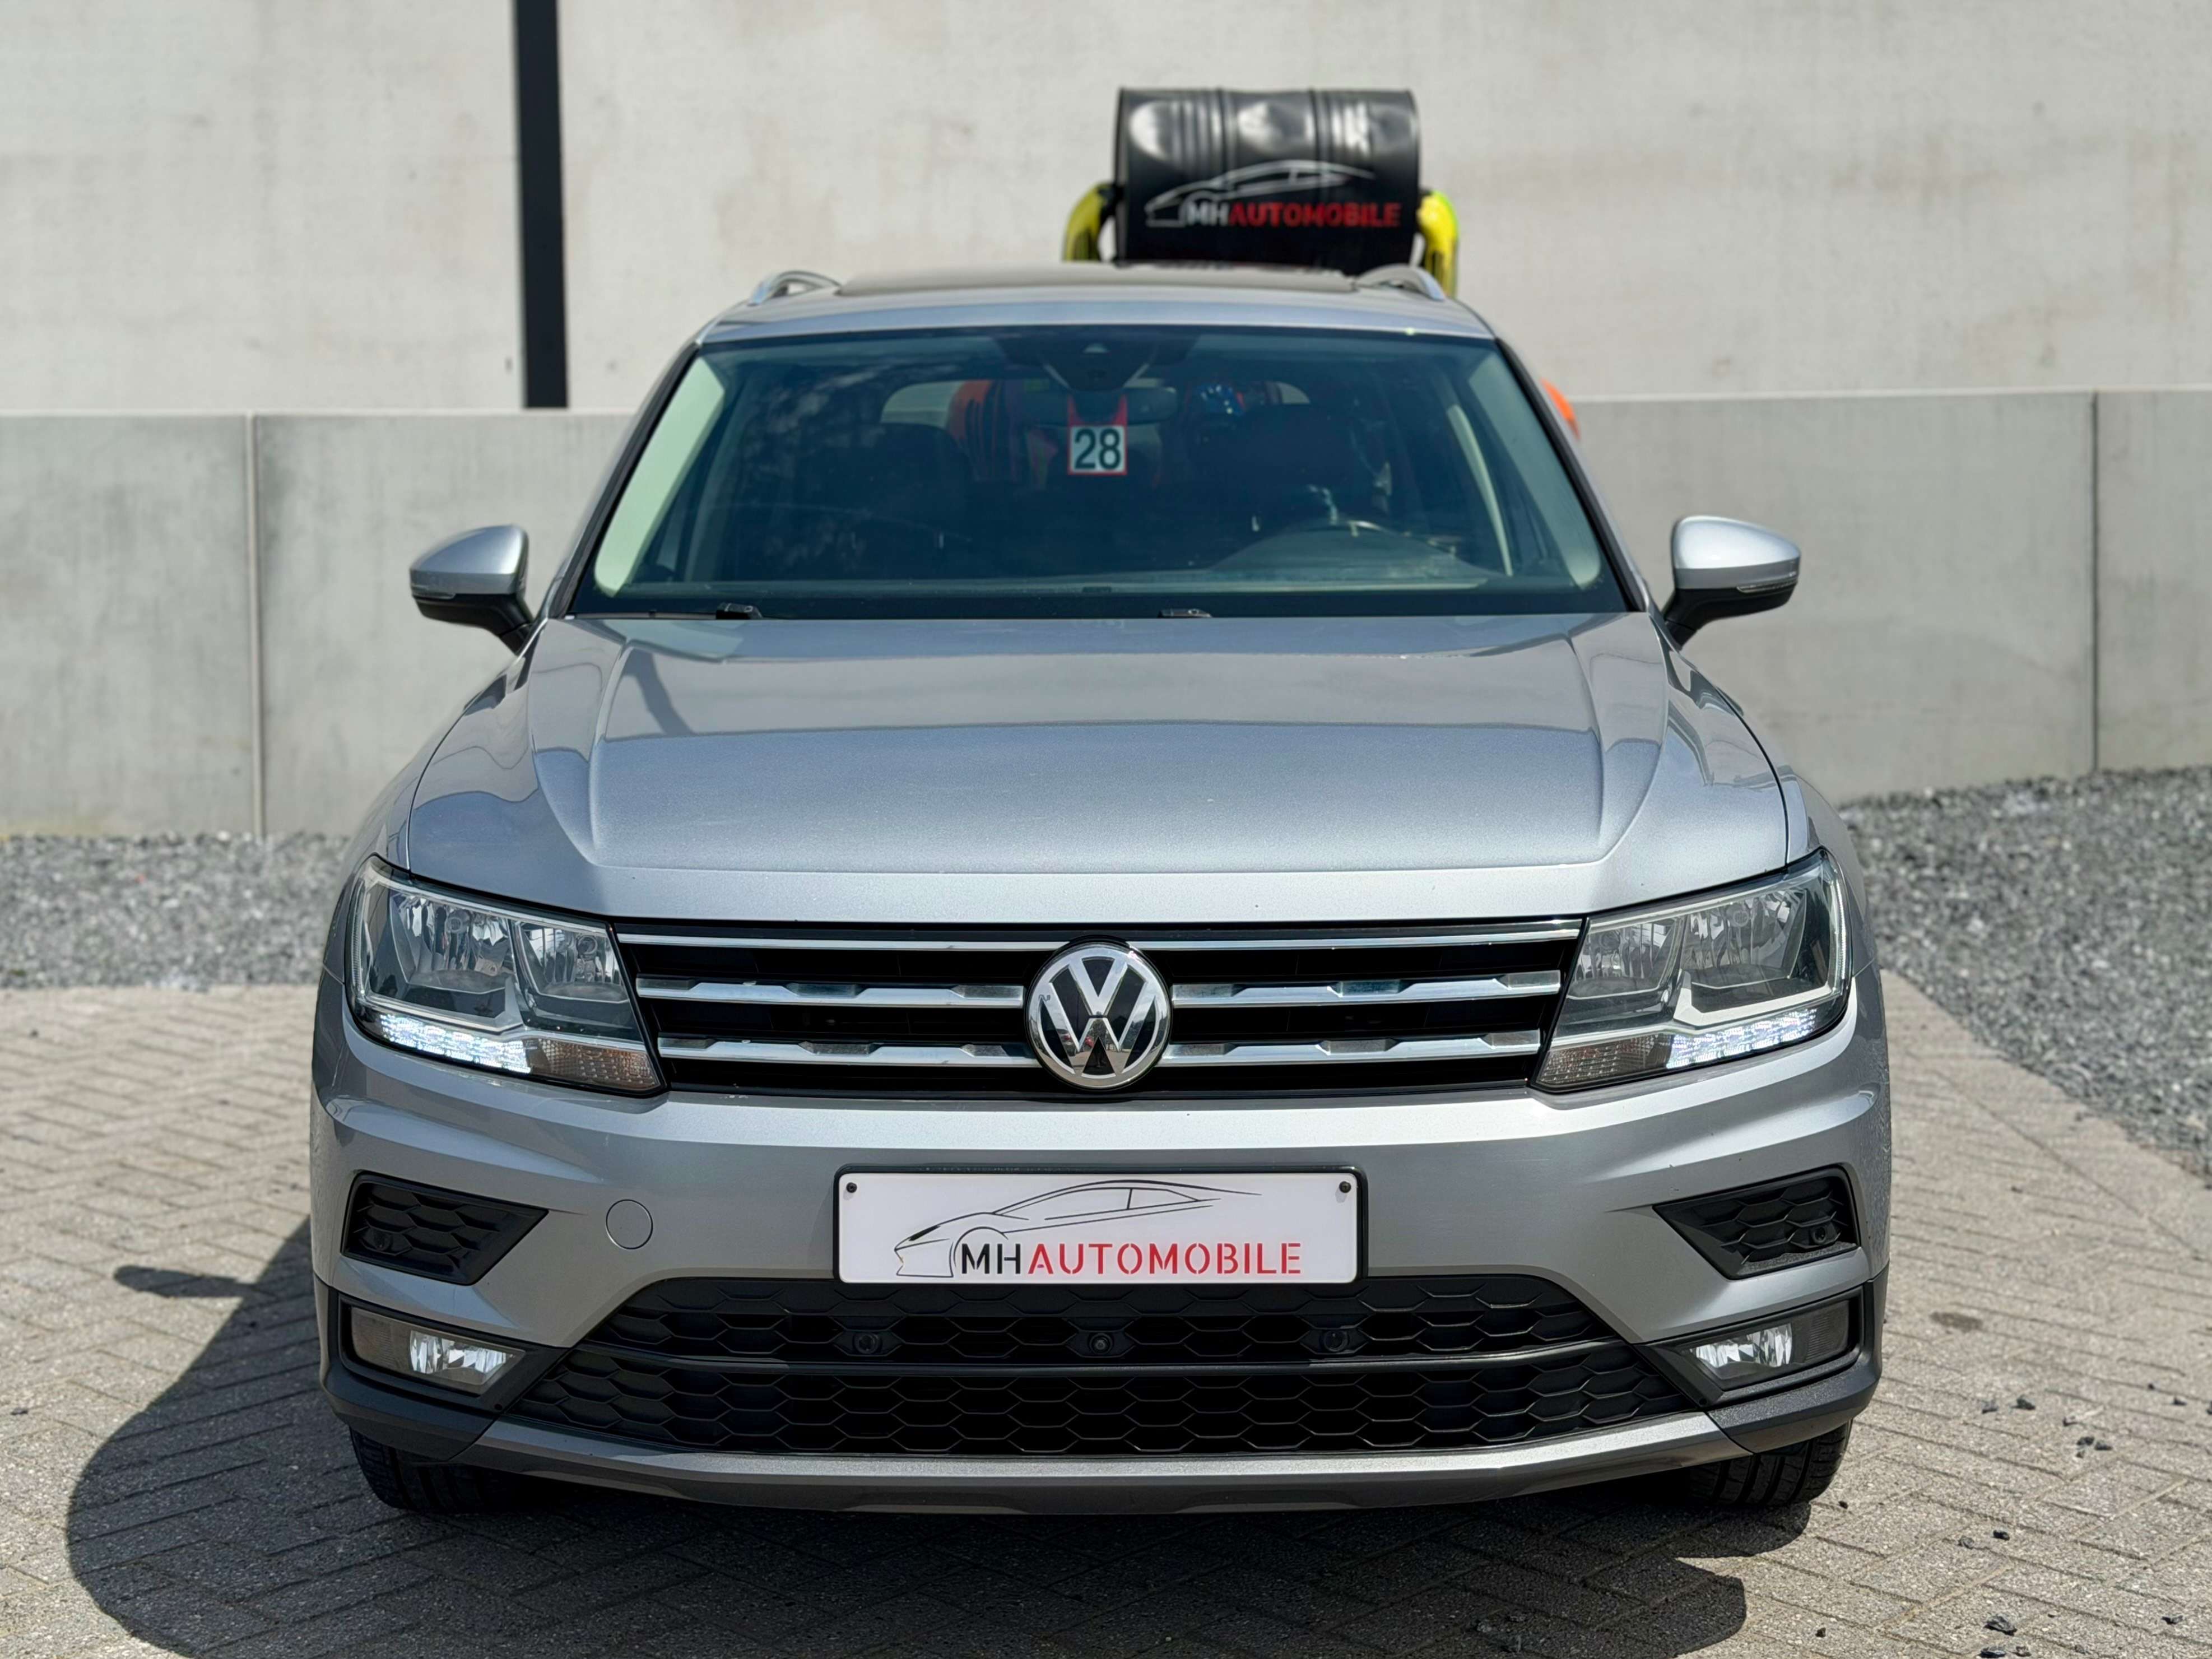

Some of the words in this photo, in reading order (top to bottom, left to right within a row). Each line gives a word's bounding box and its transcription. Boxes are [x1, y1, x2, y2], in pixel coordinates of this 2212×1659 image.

[1187, 202, 1401, 227] MHAUTOMOBILE
[1074, 427, 1122, 470] 28
[1031, 945, 1167, 1086] VW
[961, 1243, 1302, 1275] MHAUTOMOBILE
